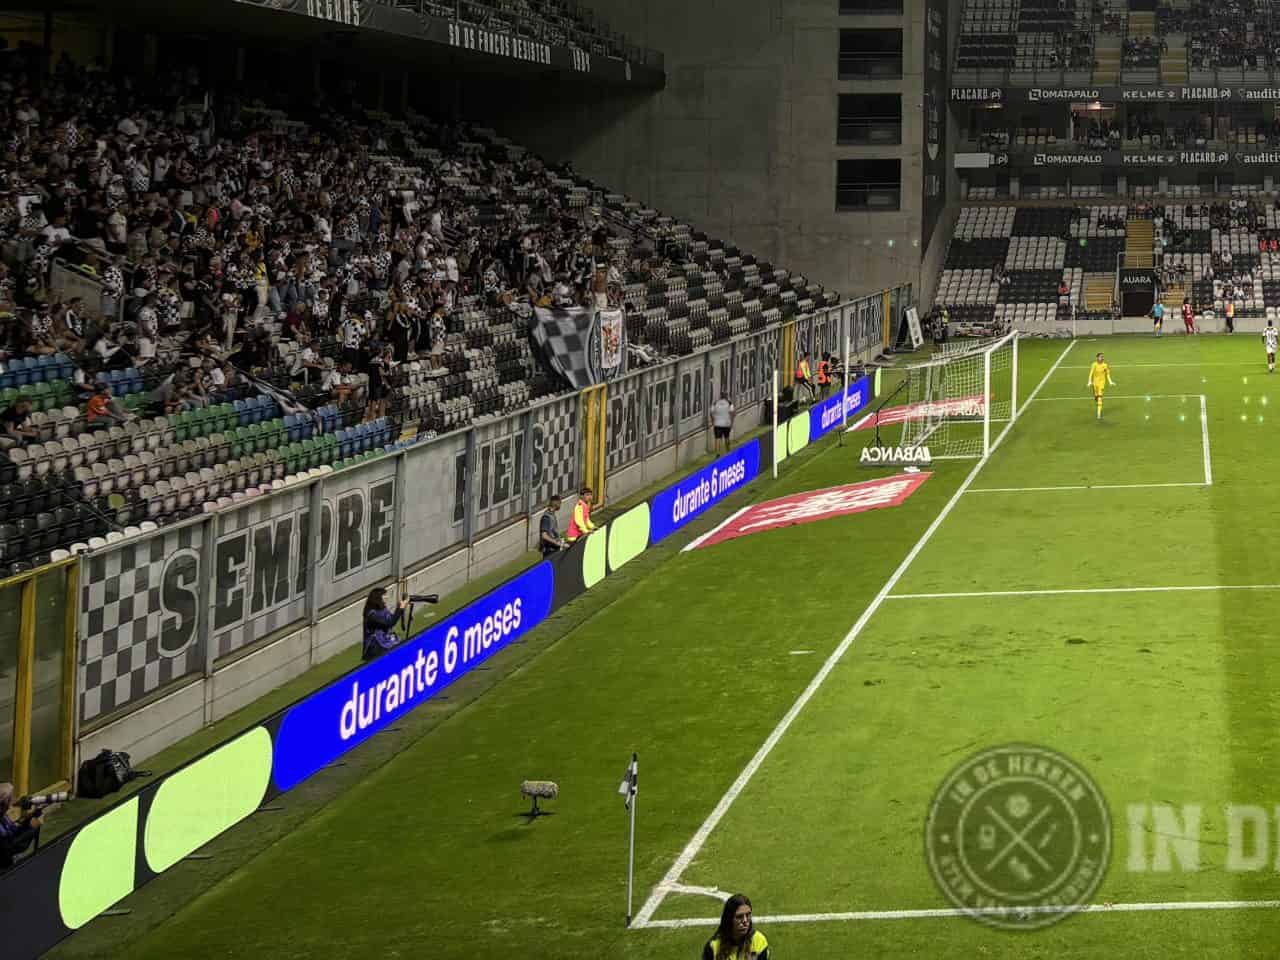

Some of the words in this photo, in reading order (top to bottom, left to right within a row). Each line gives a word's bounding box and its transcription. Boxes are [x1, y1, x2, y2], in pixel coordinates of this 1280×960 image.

[1123, 276, 1152, 284] AUARA
[672, 477, 709, 523] durante
[711, 468, 719, 498] 6
[719, 458, 745, 493] meses
[340, 649, 438, 740] durante
[444, 626, 459, 674] 6
[463, 597, 522, 663] meses
